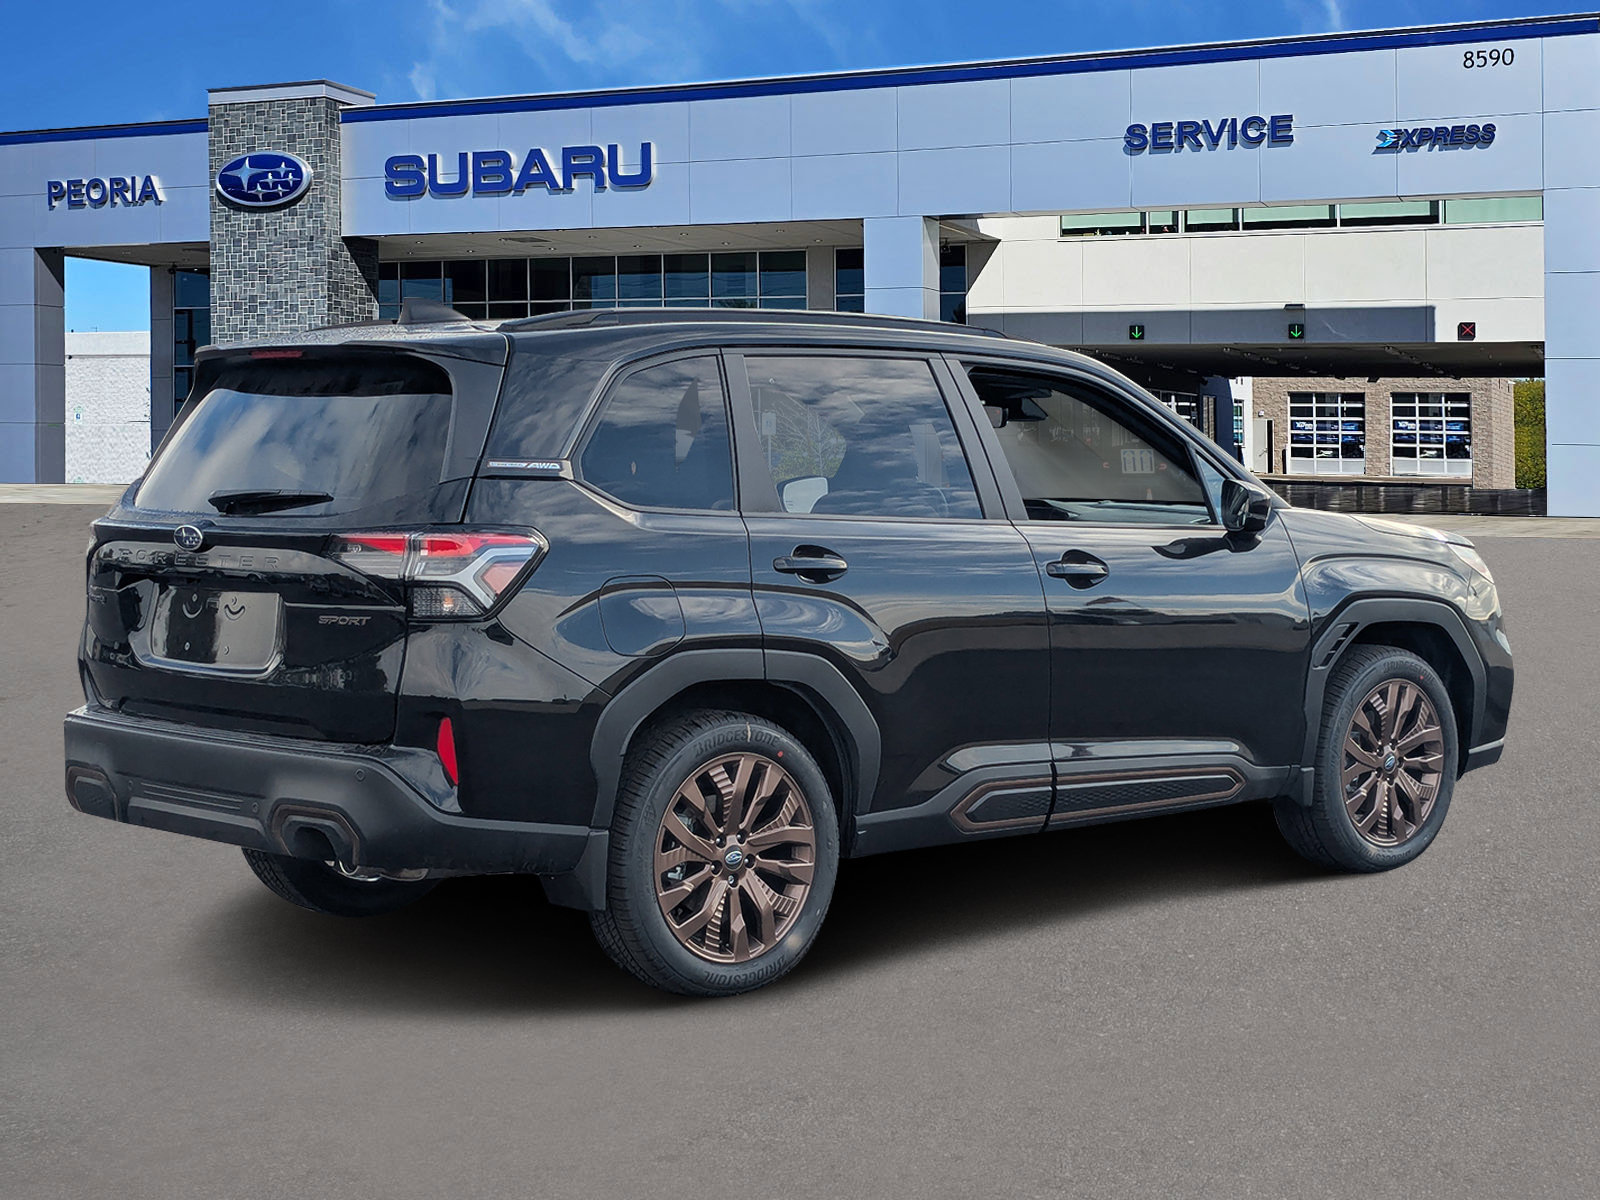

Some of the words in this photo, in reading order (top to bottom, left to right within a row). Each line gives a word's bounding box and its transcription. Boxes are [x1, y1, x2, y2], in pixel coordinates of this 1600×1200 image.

[1463, 48, 1515, 68] 8590
[1125, 114, 1294, 151] SERVICE
[1375, 123, 1497, 149] EXPRESS
[384, 142, 652, 199] SUBARU
[47, 175, 162, 209] PEORIA
[527, 462, 561, 470] AWD
[118, 548, 280, 569] FORESTER
[318, 615, 372, 626] SPORT
